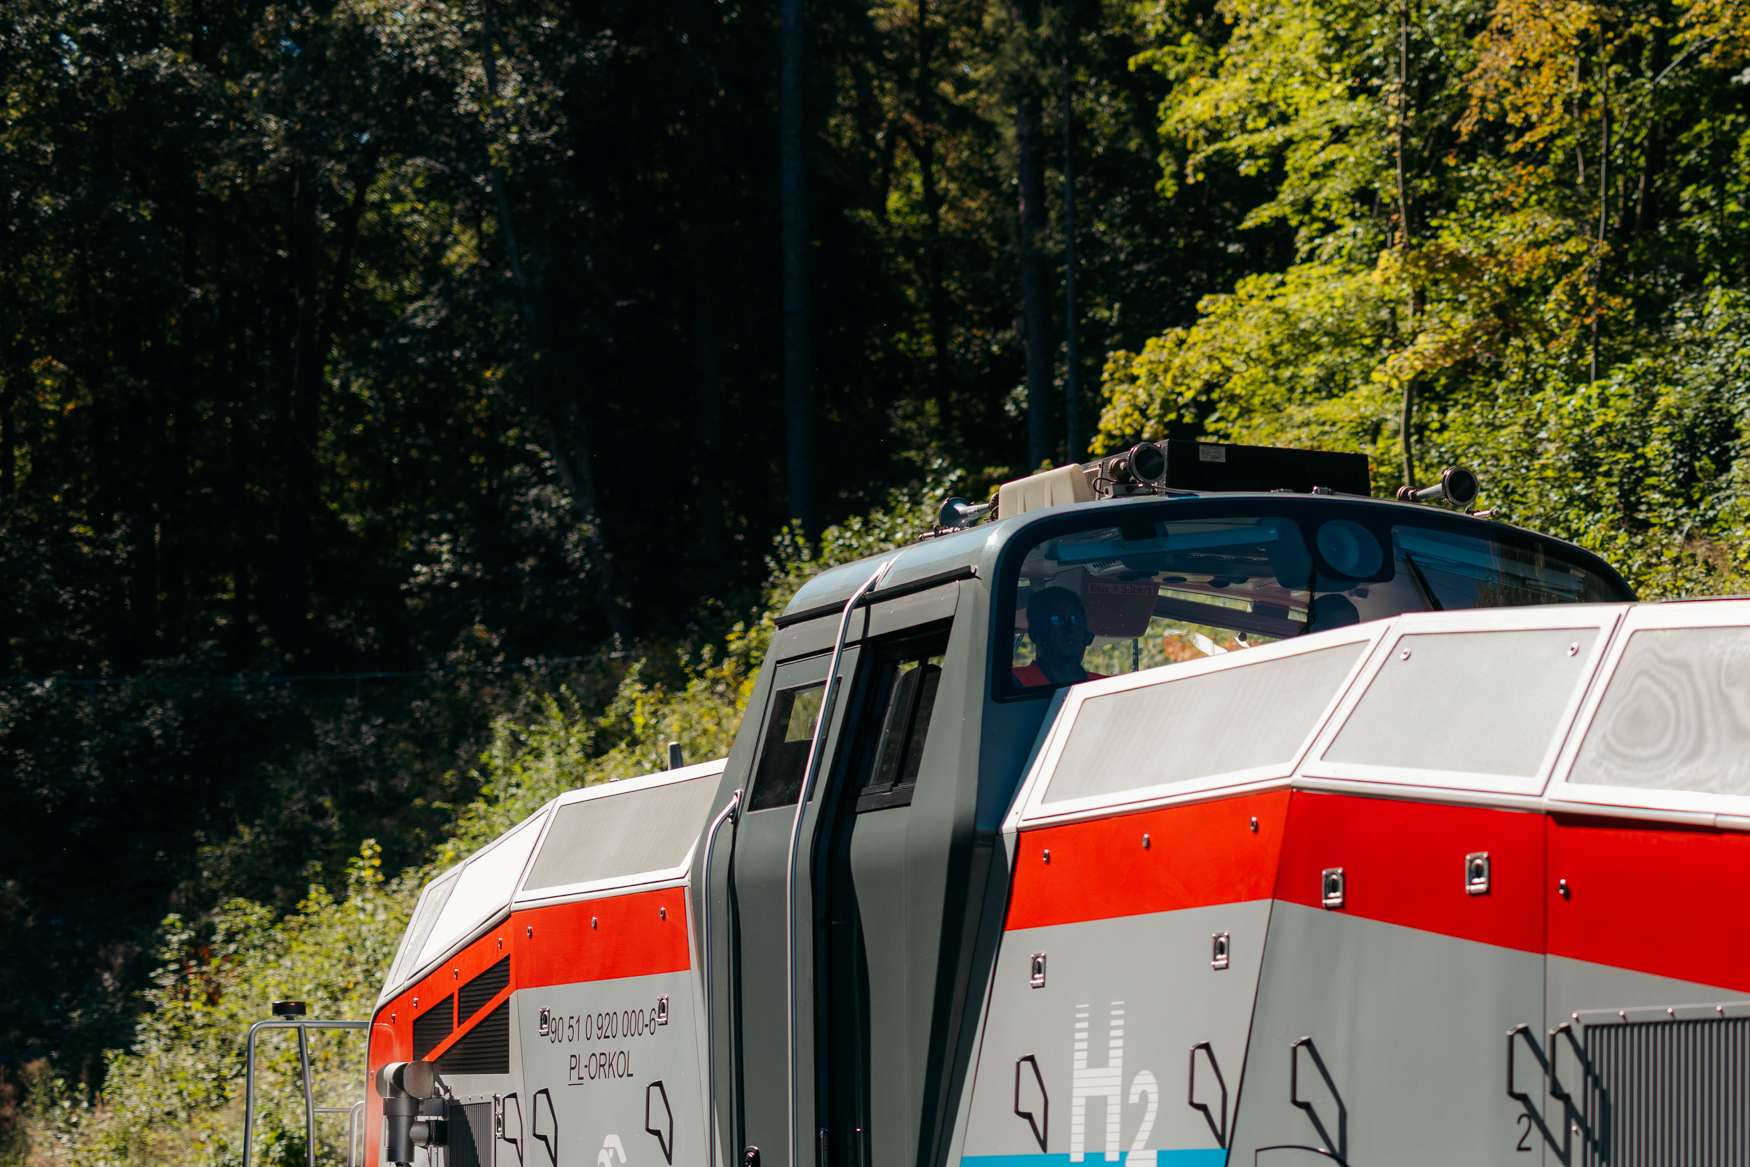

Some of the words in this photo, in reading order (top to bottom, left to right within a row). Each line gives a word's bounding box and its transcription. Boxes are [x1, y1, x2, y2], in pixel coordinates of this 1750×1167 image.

[550, 1017, 564, 1043] 90
[568, 1015, 581, 1042] 51
[585, 1014, 593, 1041] 0
[596, 1011, 618, 1040] 920
[622, 1008, 657, 1038] 000-6
[569, 1050, 634, 1081] PL-ORKOL
[1516, 1113, 1532, 1152] 2
